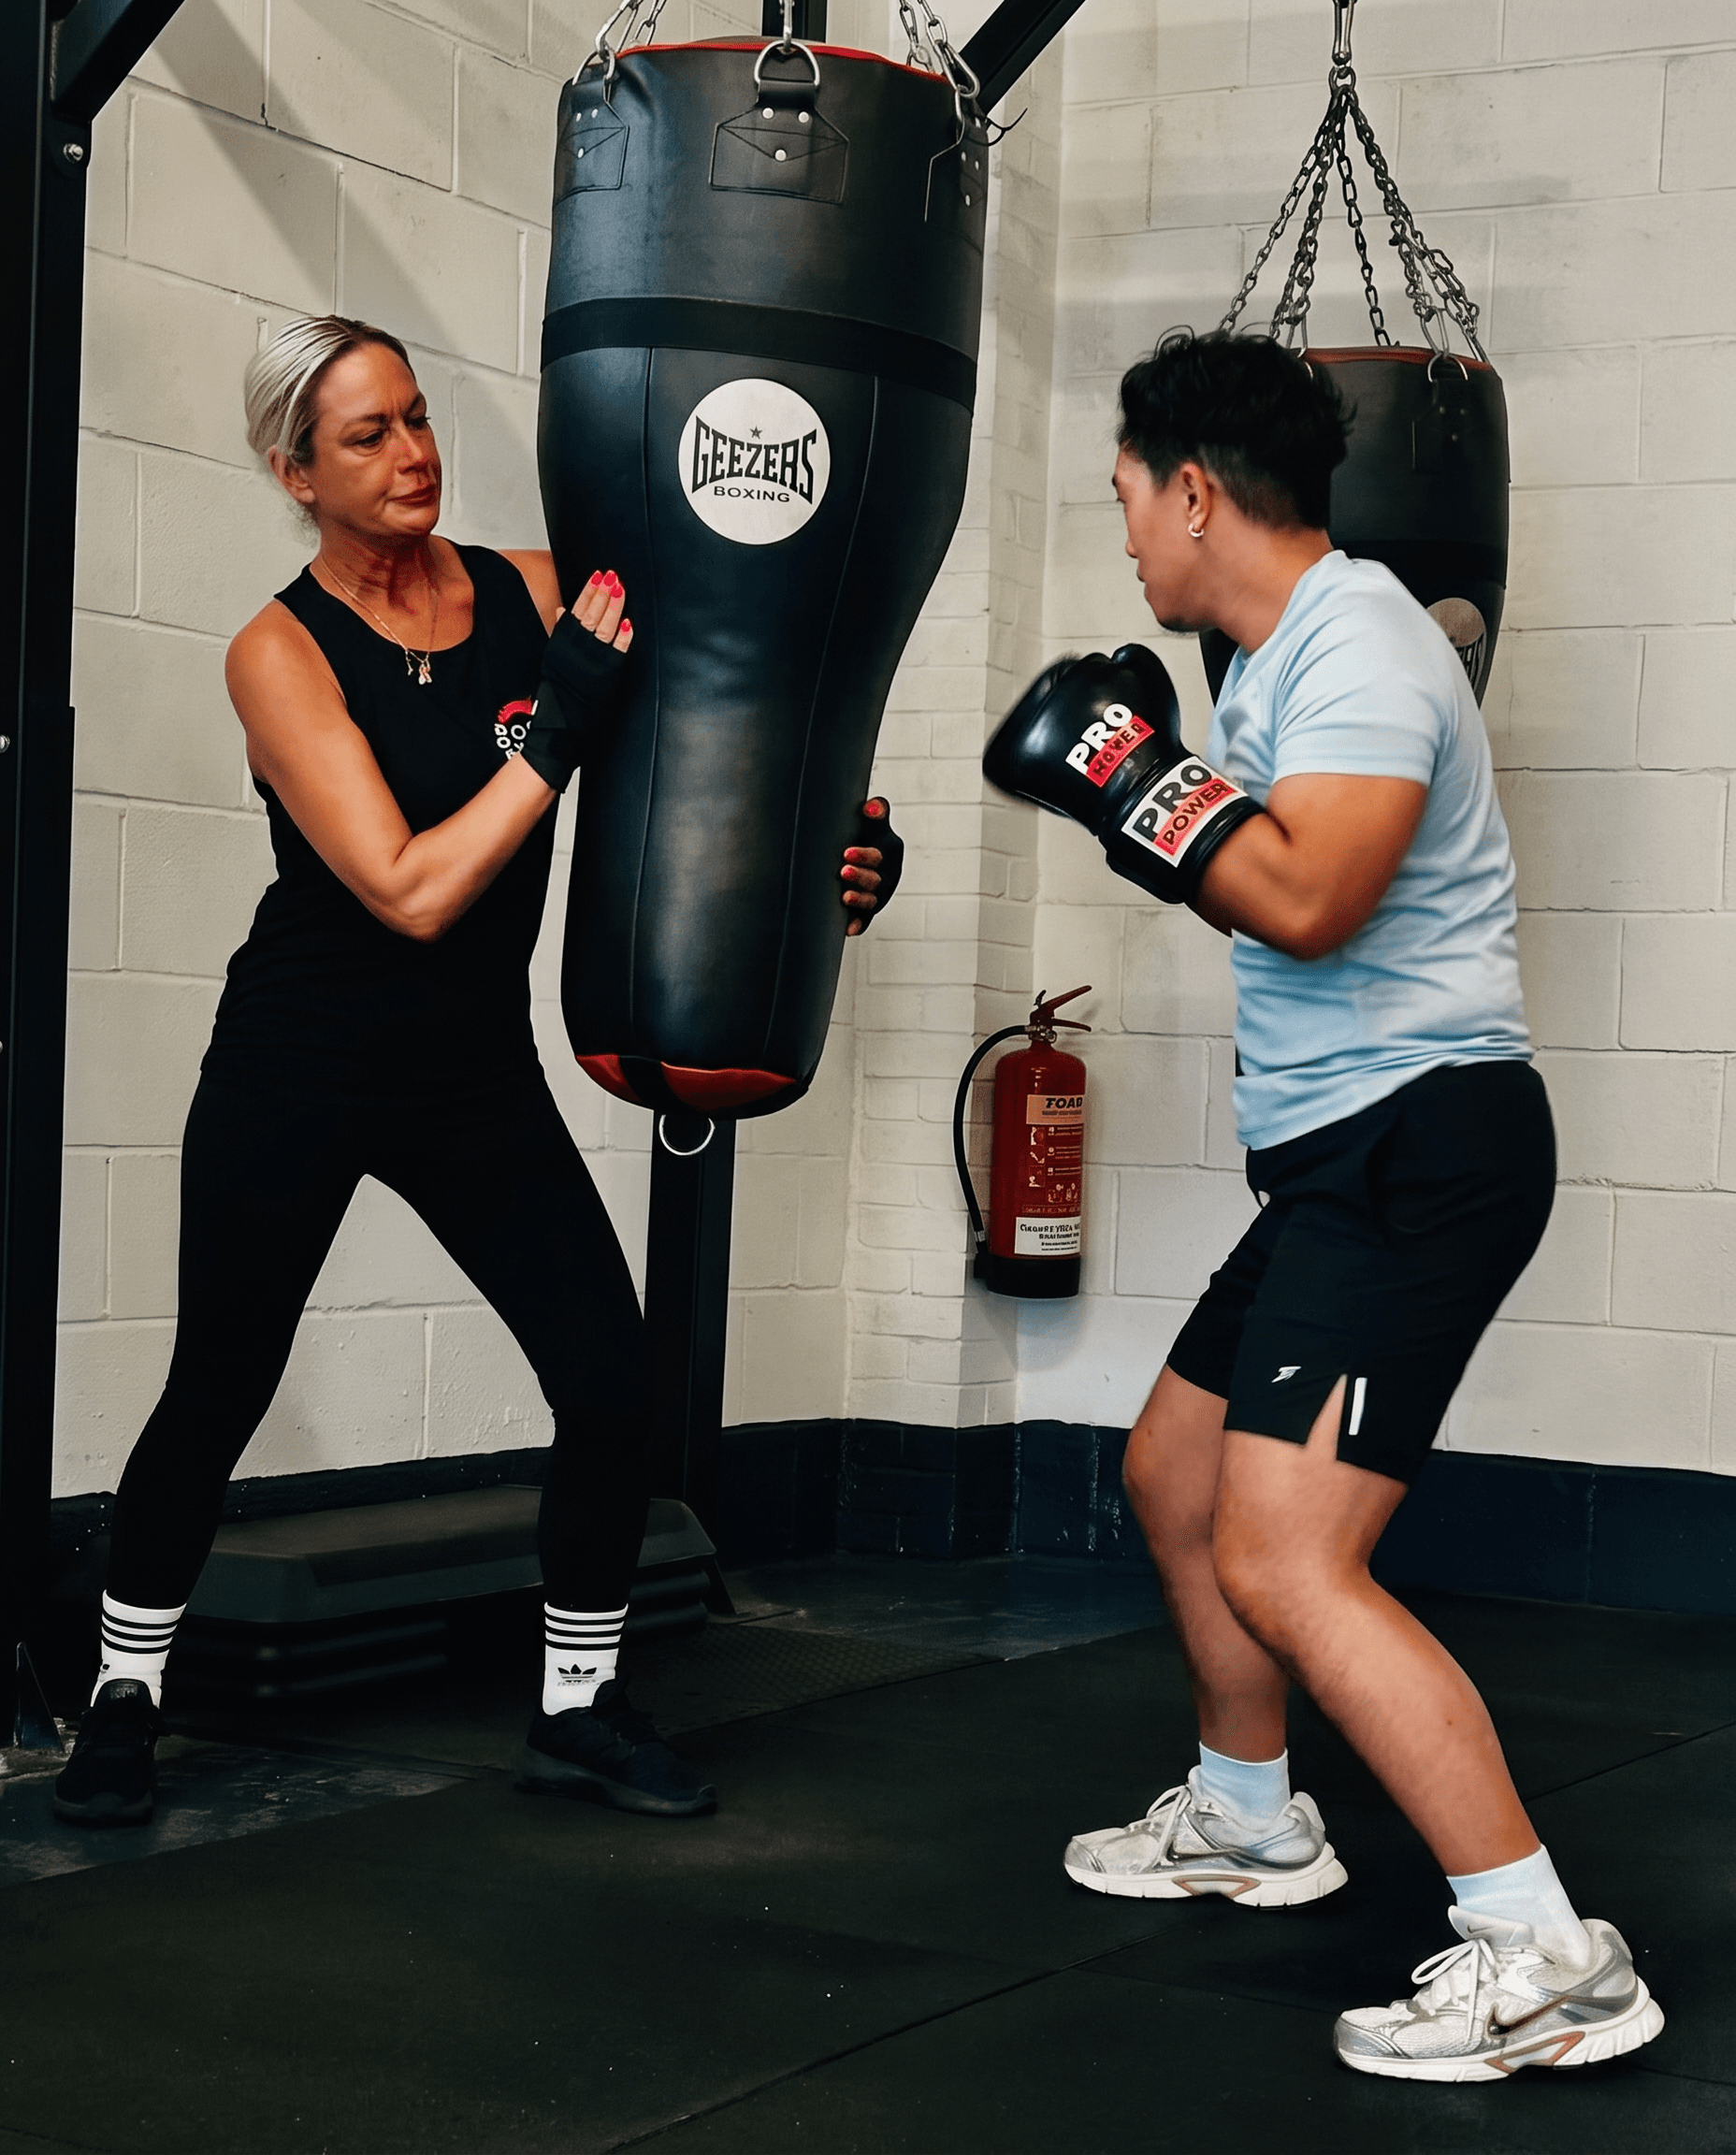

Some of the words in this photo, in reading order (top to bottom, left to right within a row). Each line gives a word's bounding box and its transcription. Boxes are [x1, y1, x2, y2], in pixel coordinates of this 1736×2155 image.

[691, 414, 817, 505] GEEZERS
[714, 485, 790, 503] BOXING
[1064, 702, 1134, 775] PRO
[1132, 764, 1213, 843] PRO
[1163, 782, 1230, 846] POWER
